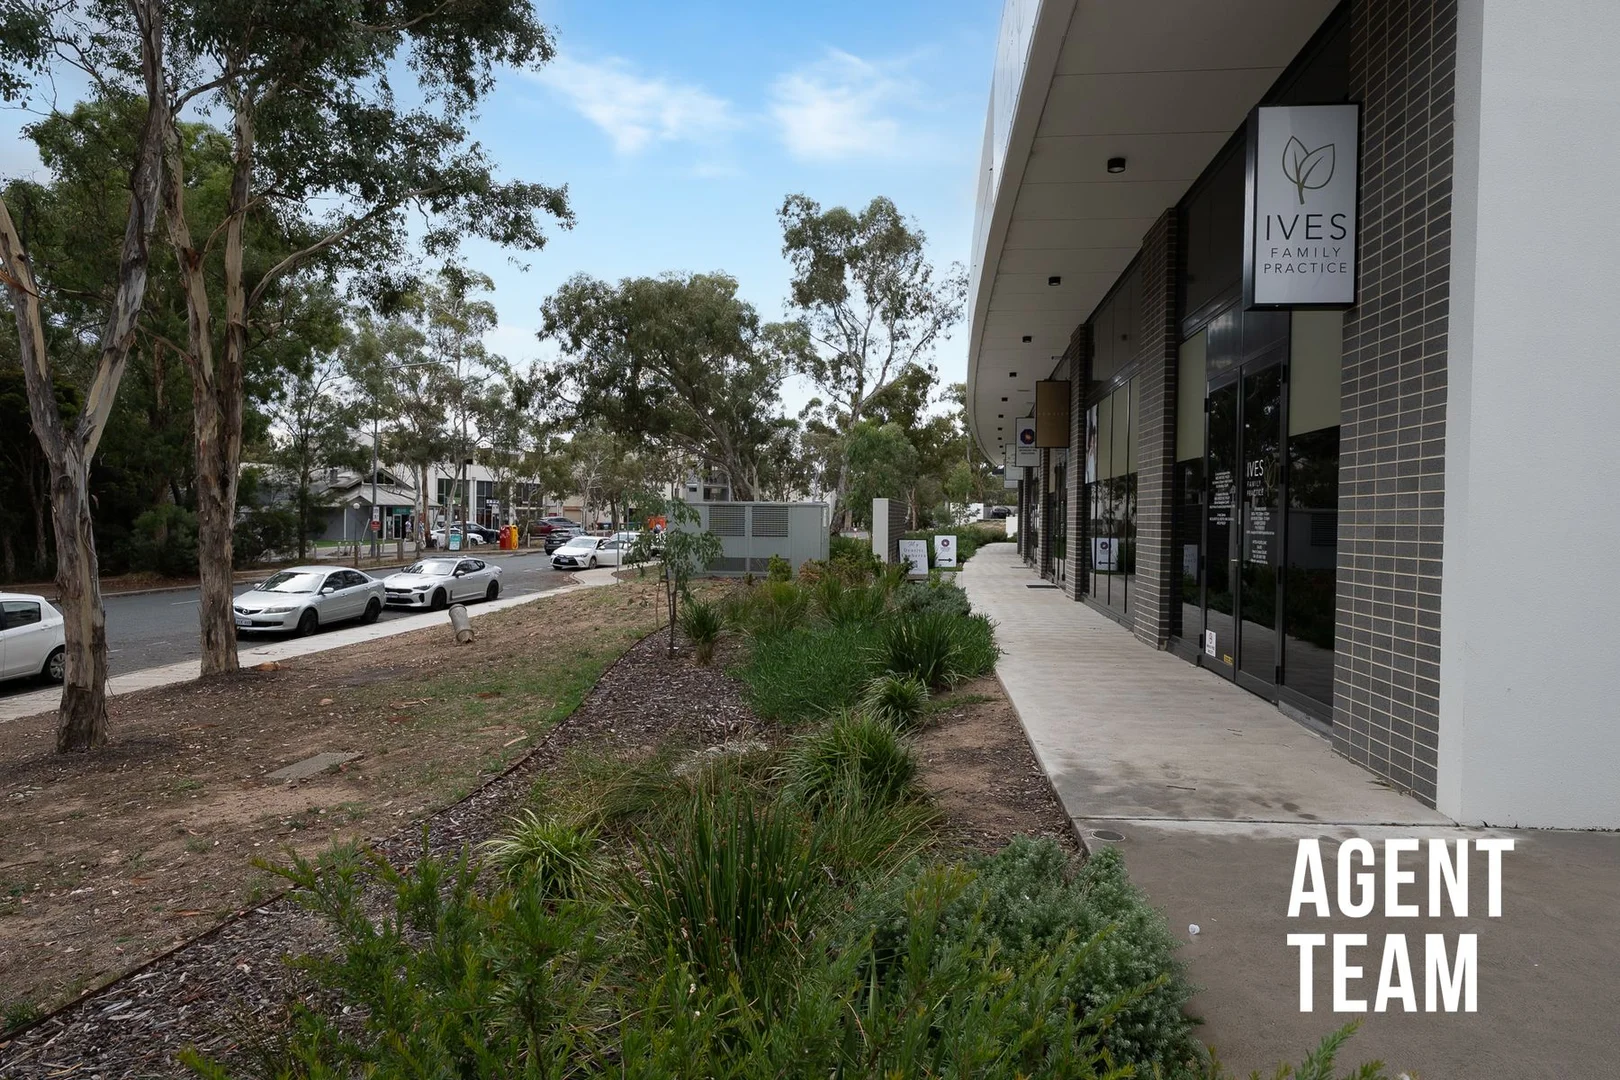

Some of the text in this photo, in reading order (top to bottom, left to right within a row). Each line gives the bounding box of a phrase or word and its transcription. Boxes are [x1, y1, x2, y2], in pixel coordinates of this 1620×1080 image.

[1266, 213, 1347, 241] IVES
[1270, 247, 1341, 258] FAMILY
[1263, 262, 1347, 274] PRACTICE
[1246, 459, 1264, 478] IVES
